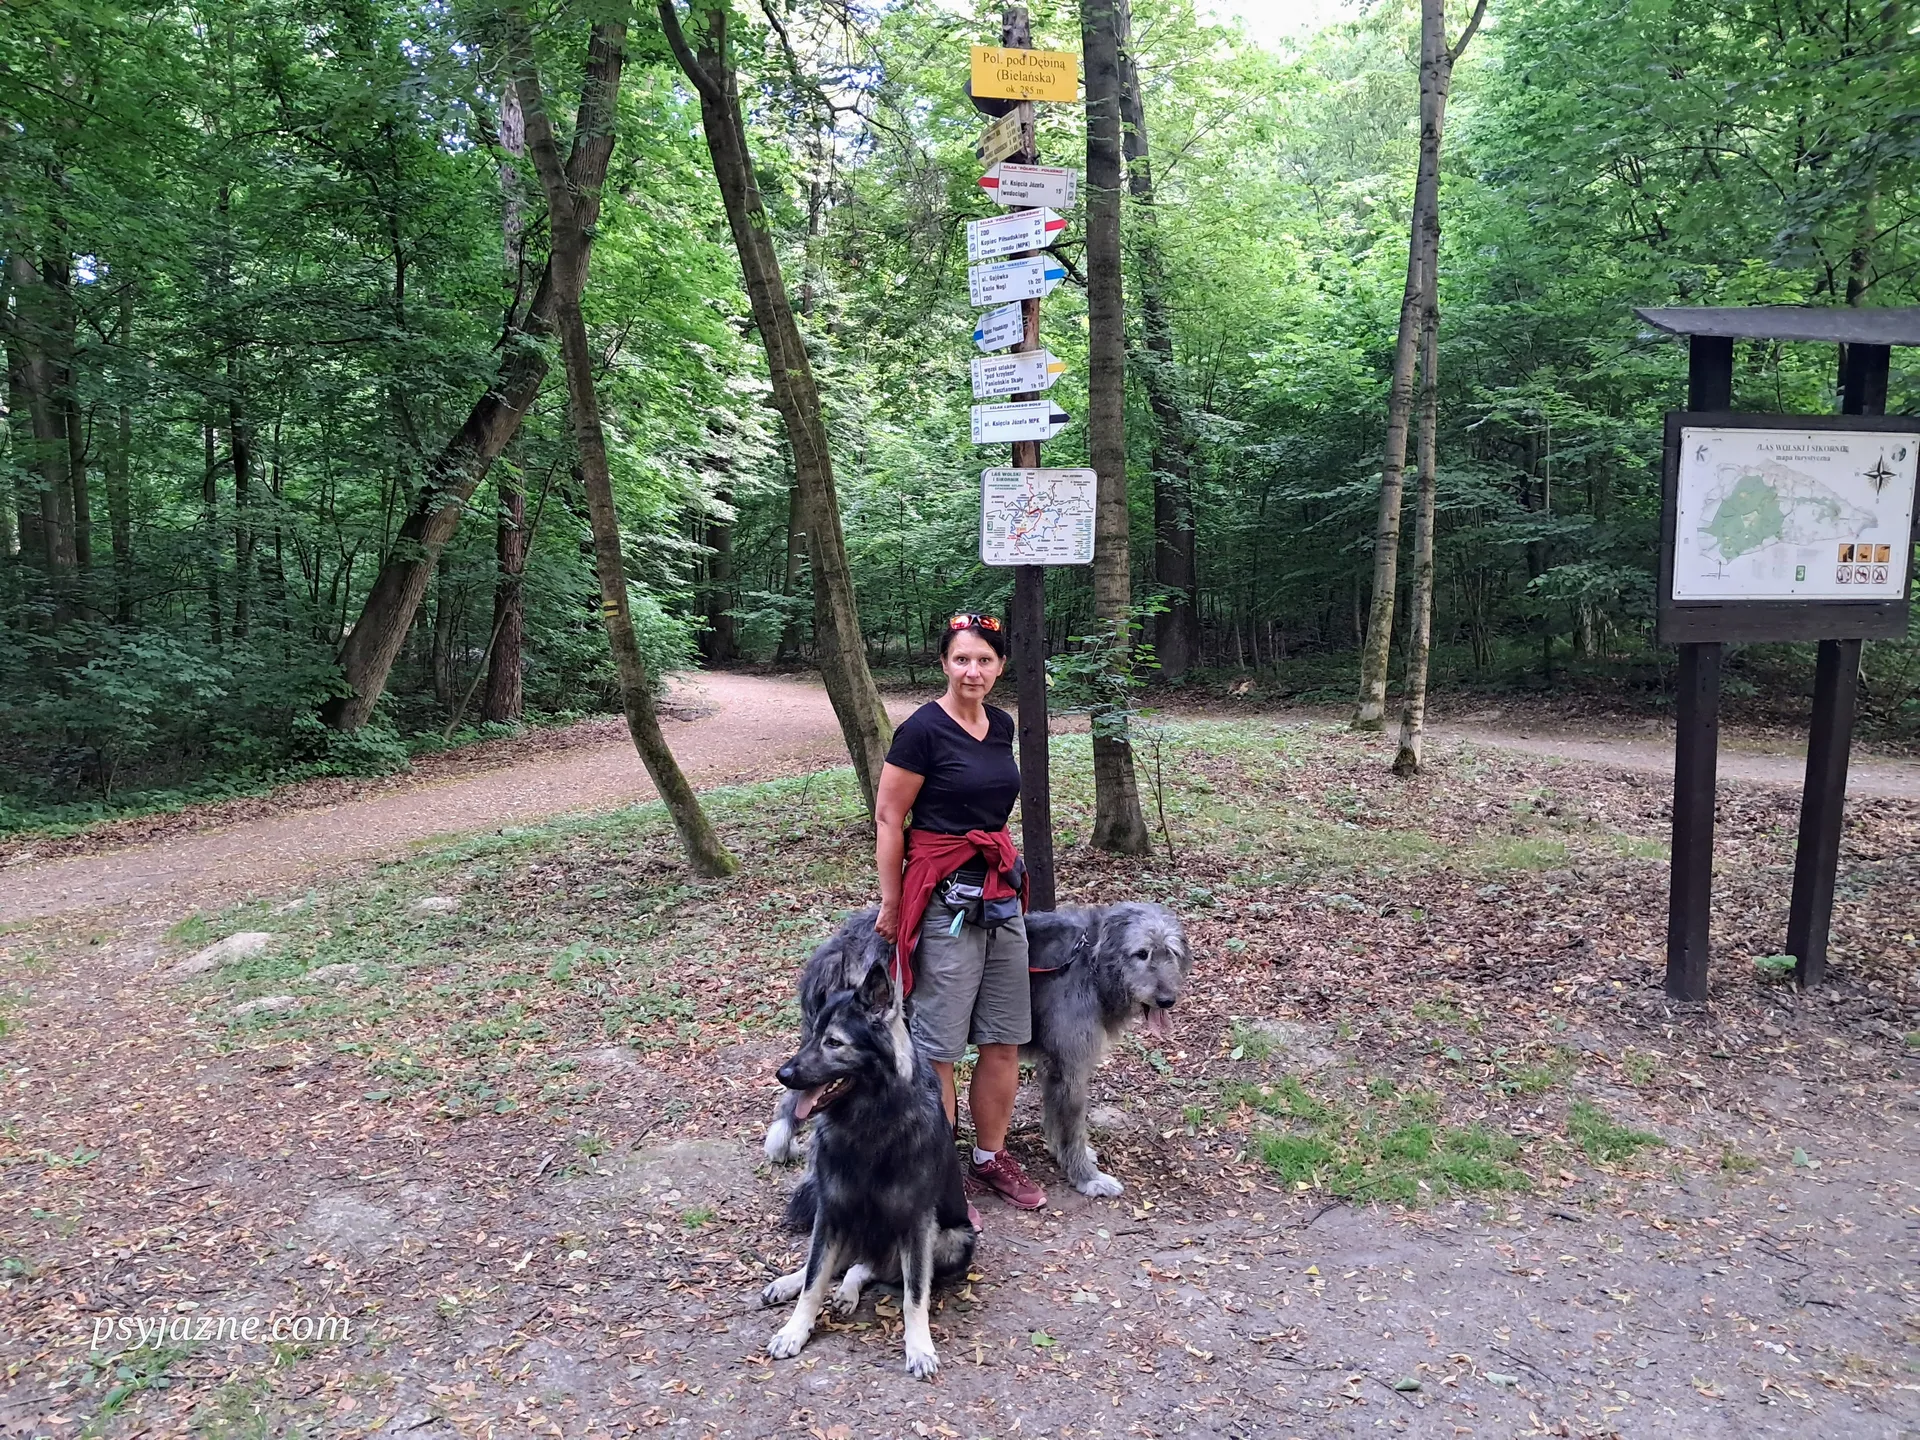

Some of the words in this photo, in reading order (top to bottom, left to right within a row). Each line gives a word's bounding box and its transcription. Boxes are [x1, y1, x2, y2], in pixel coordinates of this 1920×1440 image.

[983, 52, 1003, 64] Pol.
[1006, 55, 1026, 67] pod
[1029, 55, 1066, 71] Dębiną
[996, 69, 1056, 85] (Bielańska)
[1006, 85, 1017, 93] ok.
[1020, 86, 1034, 94] 285
[980, 238, 997, 247] Kopiec
[998, 232, 1029, 243] Piłsudskiego
